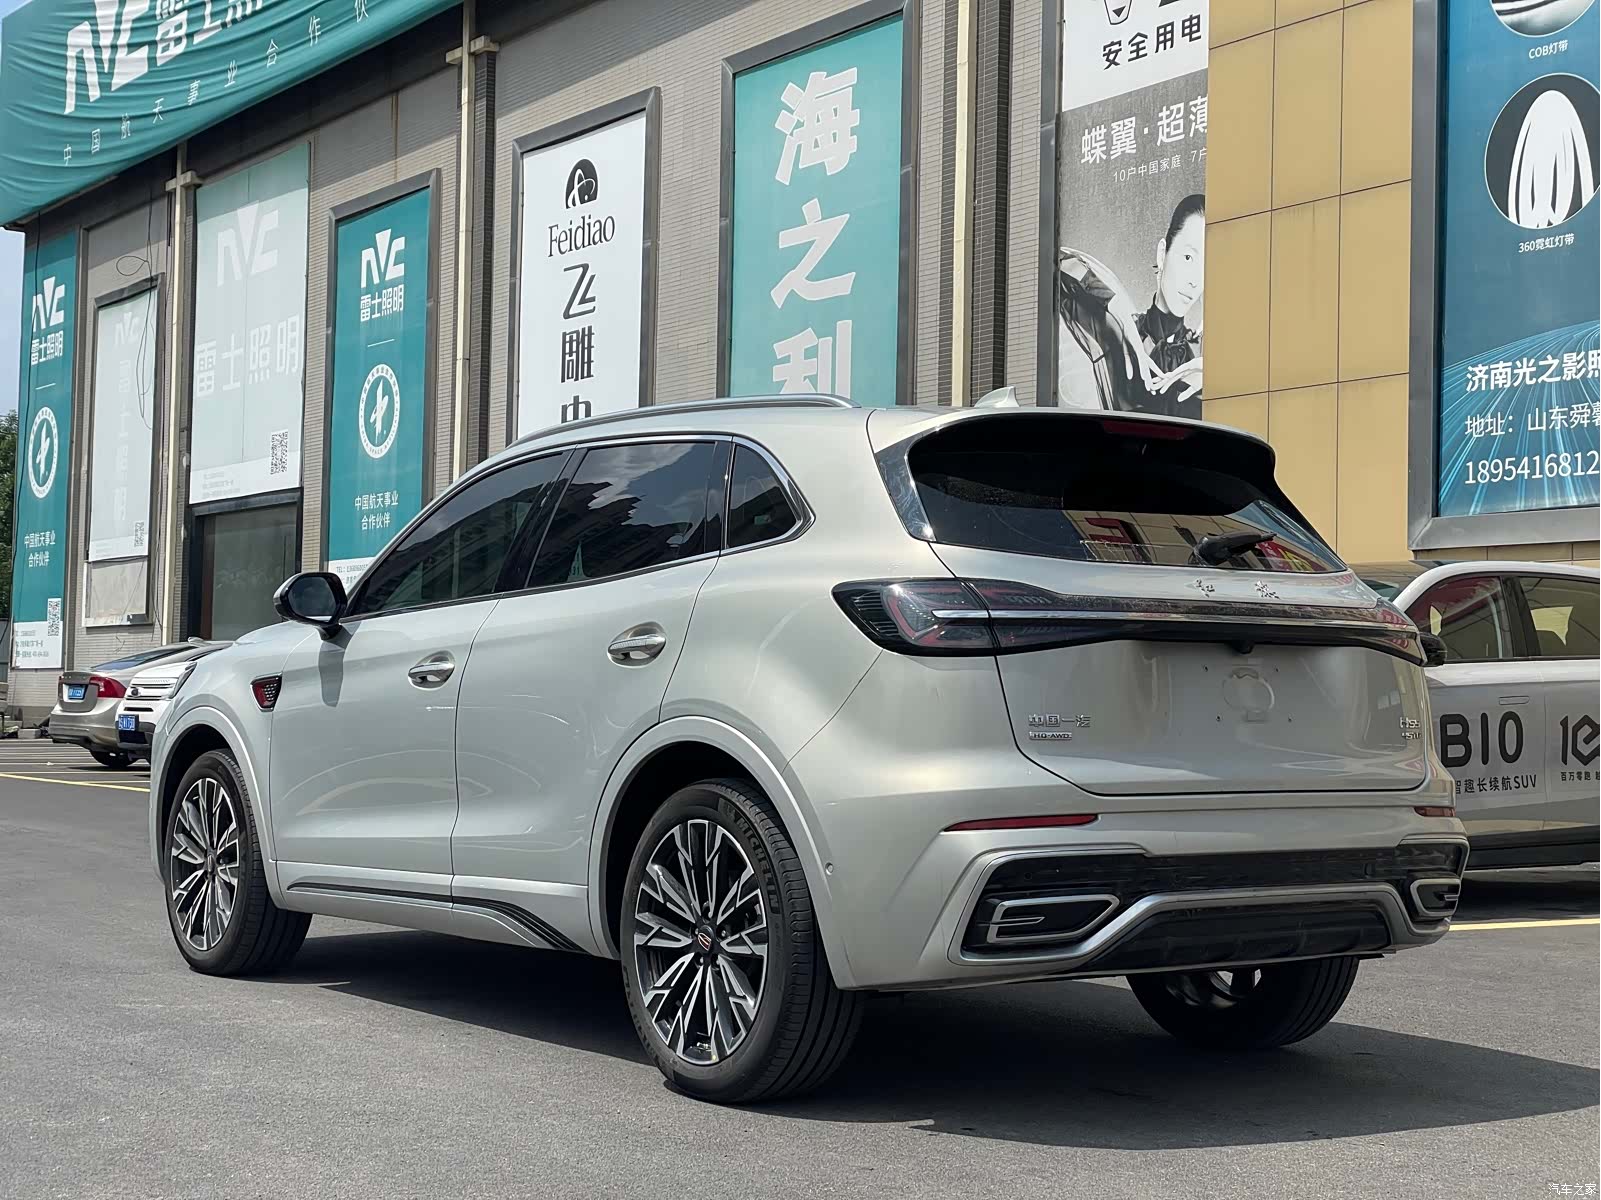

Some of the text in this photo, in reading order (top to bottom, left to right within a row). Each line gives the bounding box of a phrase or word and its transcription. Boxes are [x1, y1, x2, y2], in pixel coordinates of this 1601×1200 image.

[1102, 14, 1202, 70] 安全用电
[1528, 40, 1569, 59] COB灯带
[1113, 154, 1181, 183] 10户中国家庭
[547, 214, 616, 258] Feidiao
[770, 66, 860, 399] 海之利
[1518, 232, 1575, 253] 360霓虹灯带
[360, 283, 405, 322] 雷士照明
[31, 330, 64, 366] 雷士照明
[195, 314, 300, 398] 雷士照明
[1465, 450, 1600, 484] 1895416812
[354, 490, 399, 511] 中国航天事业
[361, 511, 391, 530] 合作伙伴
[24, 530, 56, 549] 中国航天事业
[28, 553, 49, 568] 合作伙伴
[1028, 713, 1091, 728] 中国一汽
[1439, 710, 1523, 768] B10
